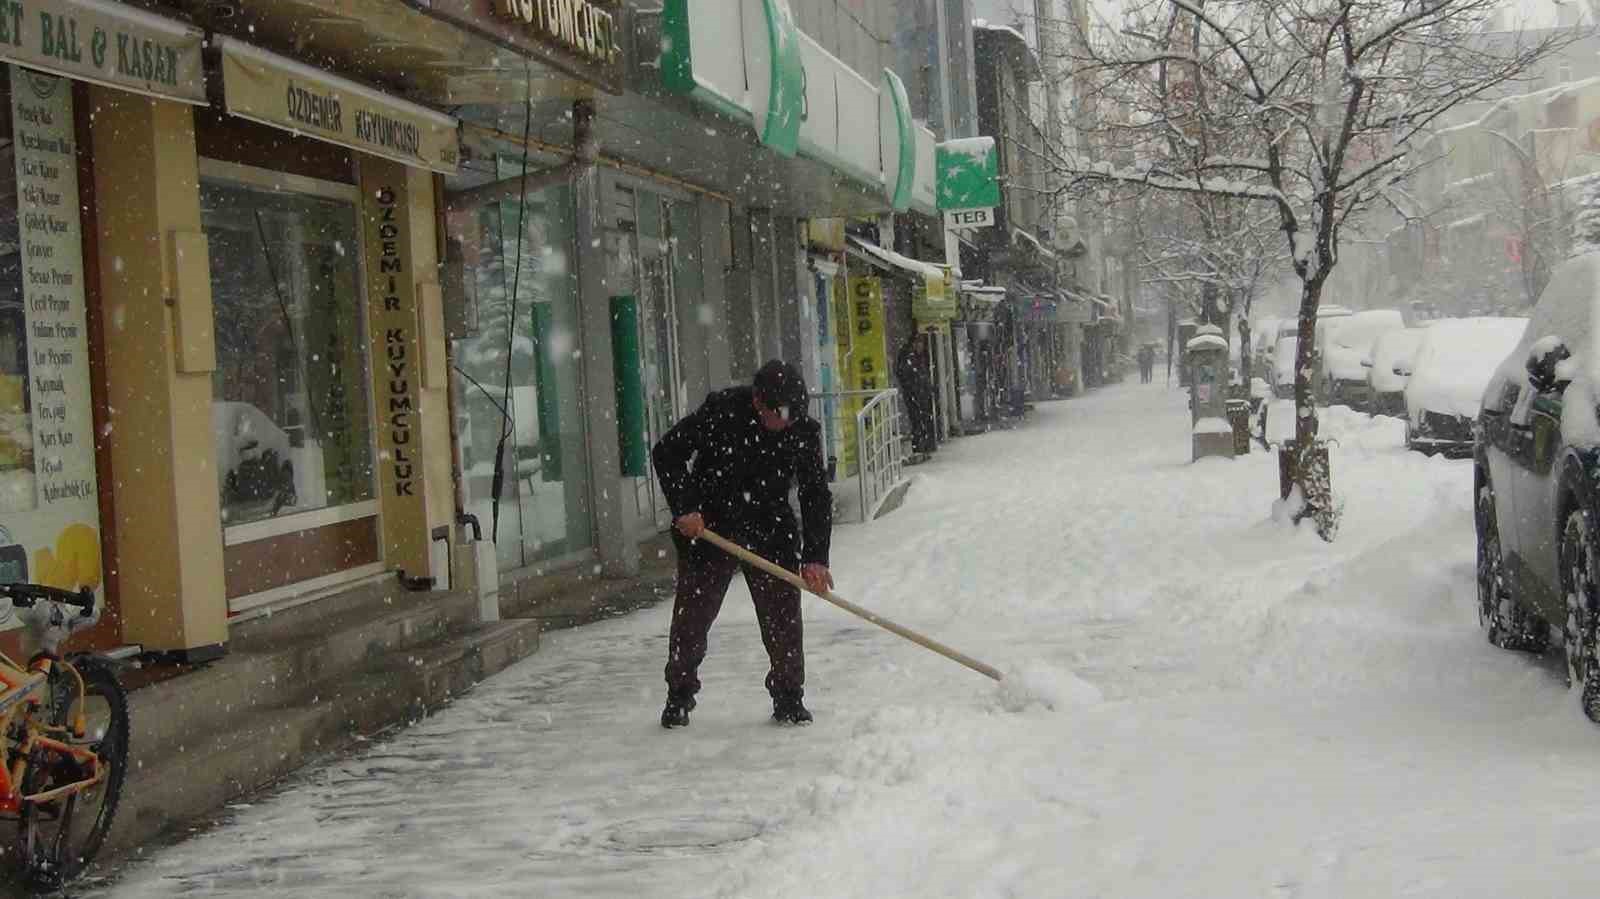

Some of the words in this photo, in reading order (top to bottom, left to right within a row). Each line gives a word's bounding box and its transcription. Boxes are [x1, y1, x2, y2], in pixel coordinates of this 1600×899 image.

[40, 11, 81, 62] BAL
[92, 27, 107, 67] &
[952, 210, 987, 225] TEB
[376, 186, 402, 311] ÖZDEMİR
[855, 281, 874, 337] CEP
[386, 328, 413, 496] KUYUMCULUK
